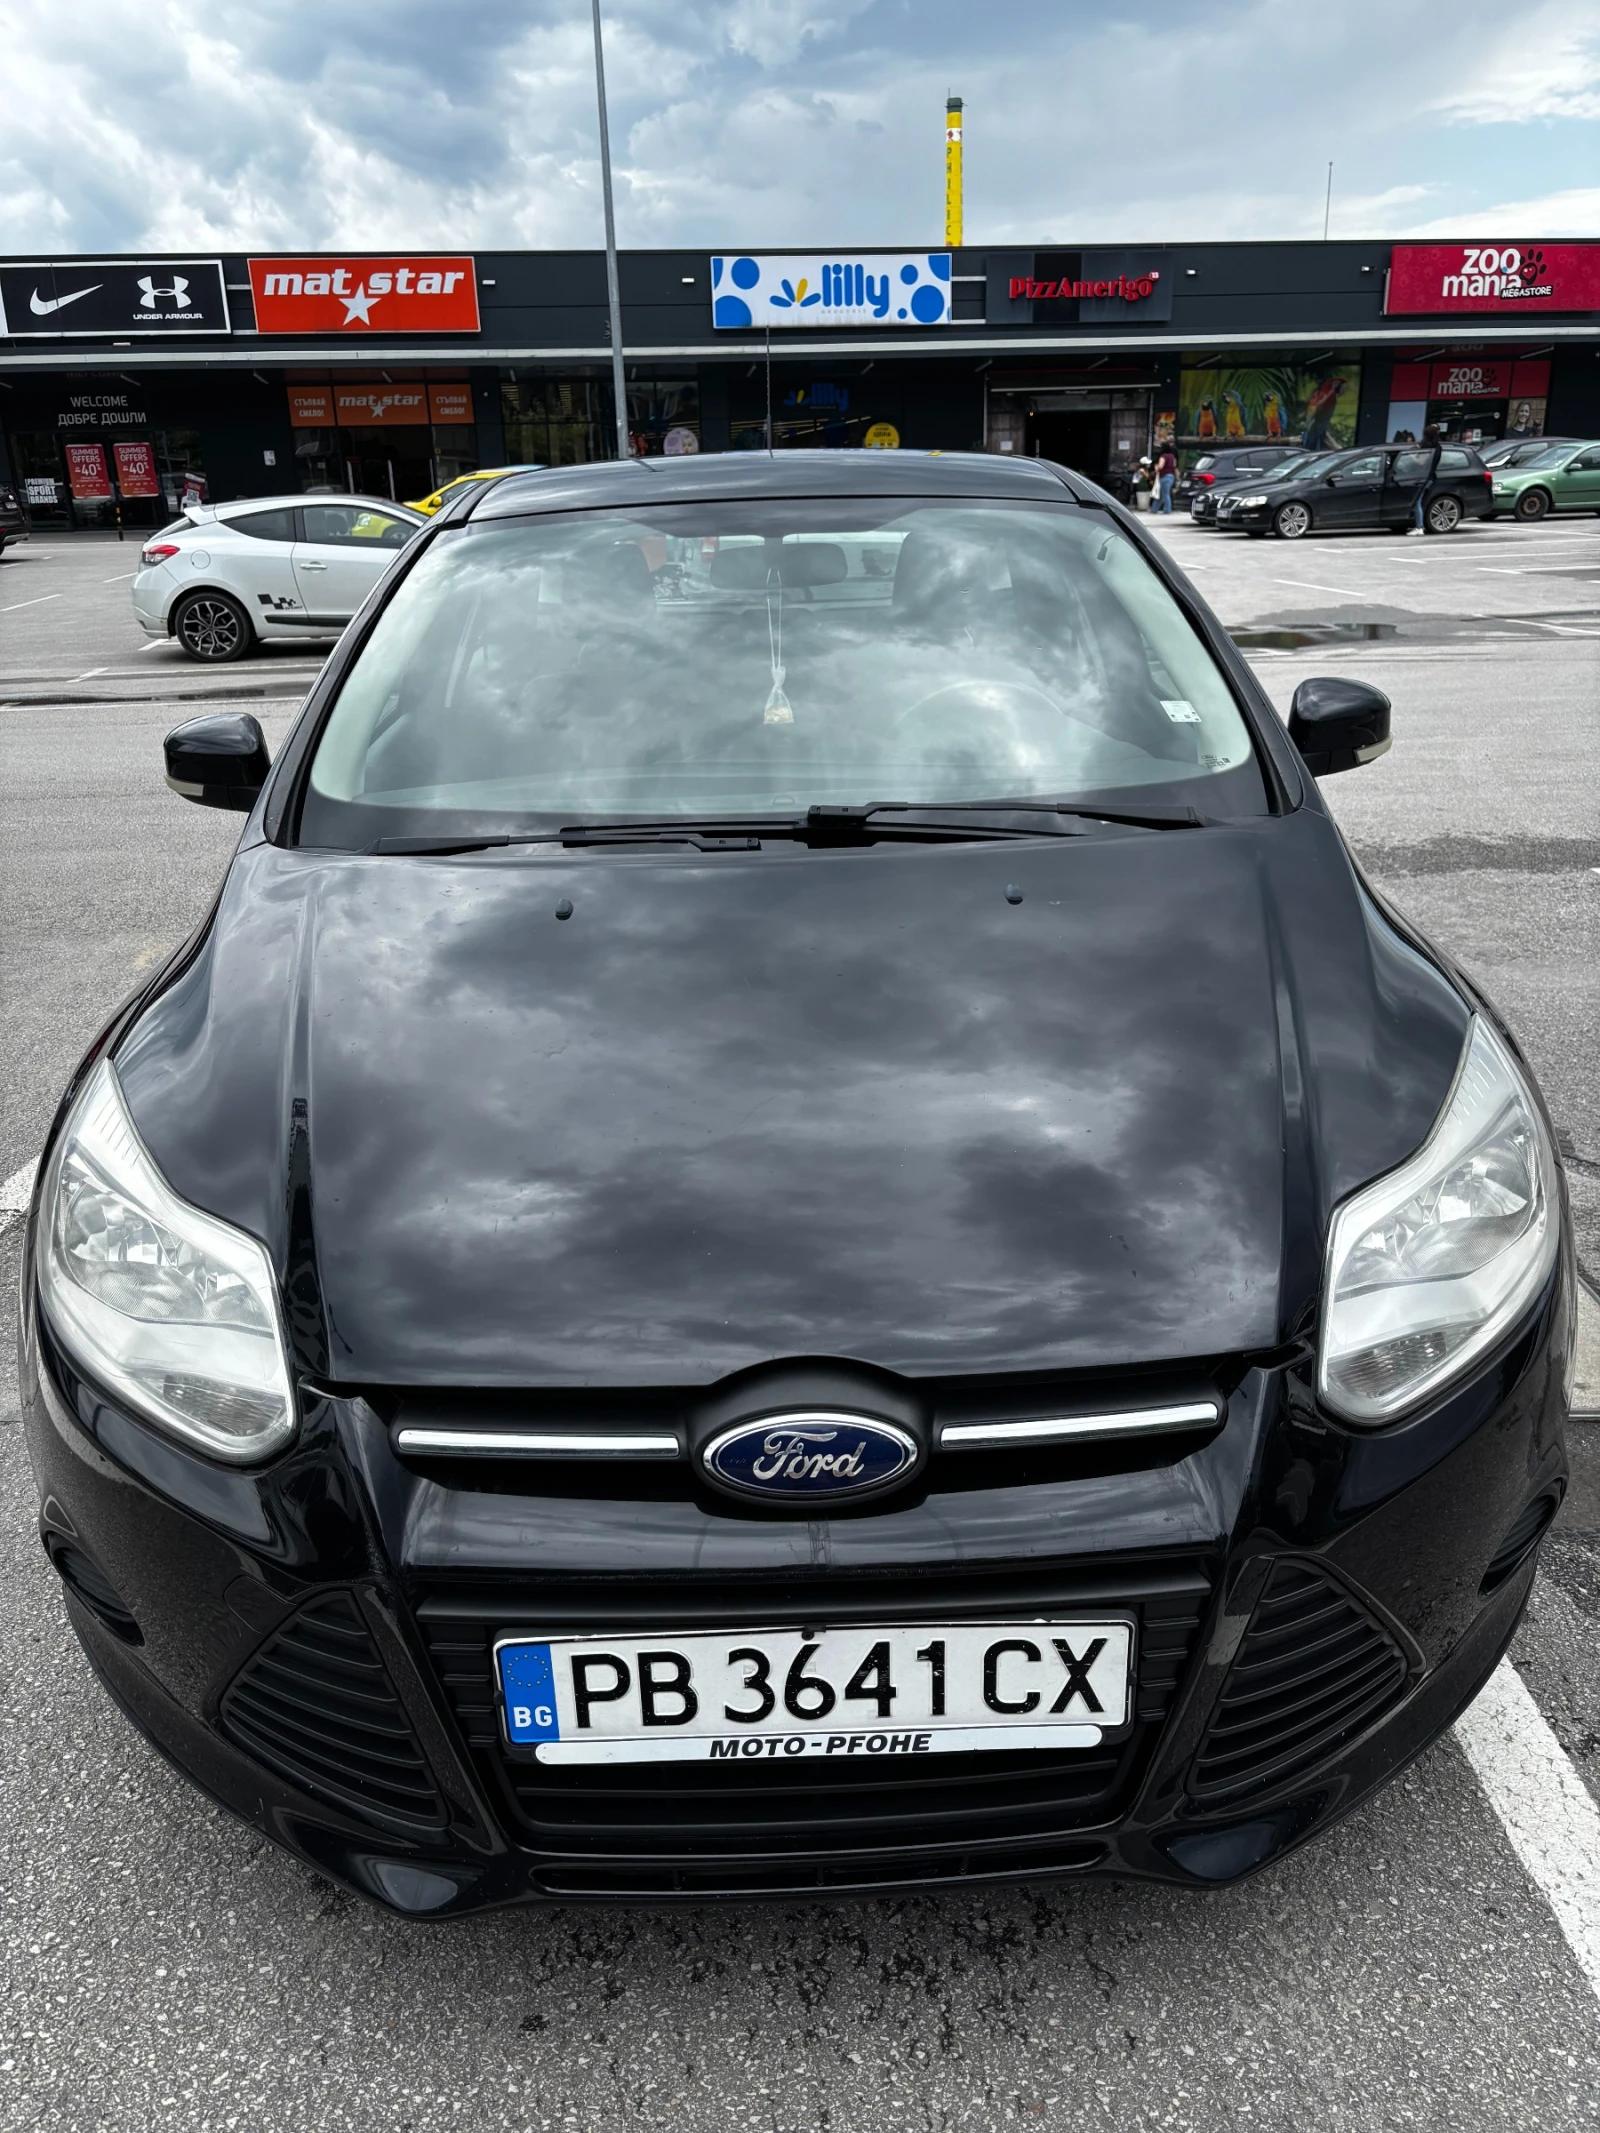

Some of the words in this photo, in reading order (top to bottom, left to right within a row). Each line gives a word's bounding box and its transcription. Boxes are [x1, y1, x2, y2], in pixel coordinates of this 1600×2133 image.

[264, 268, 352, 296] mat
[367, 268, 465, 295] star
[1009, 275, 1153, 301] PizzAmerigo
[1442, 274, 1521, 297] mania
[822, 263, 889, 318] lilly
[1502, 286, 1552, 298] MEGASTORE
[1437, 381, 1483, 394] mania
[70, 395, 128, 407] WELCOME
[339, 395, 377, 406] mat
[381, 394, 422, 406] star
[58, 413, 98, 426] ДОБРЕ
[101, 412, 147, 425] ДОШЛИ
[72, 455, 100, 463] OFFERS
[120, 454, 148, 462] OFFERS
[28, 486, 55, 495] SPORT
[30, 495, 58, 504] BRANDS
[753, 1431, 866, 1480] Ford
[724, 1640, 945, 1723] 3641
[983, 1638, 1109, 1715] CX
[513, 1706, 552, 1727] BG
[709, 1733, 932, 1758] MOTO-PFOHE
